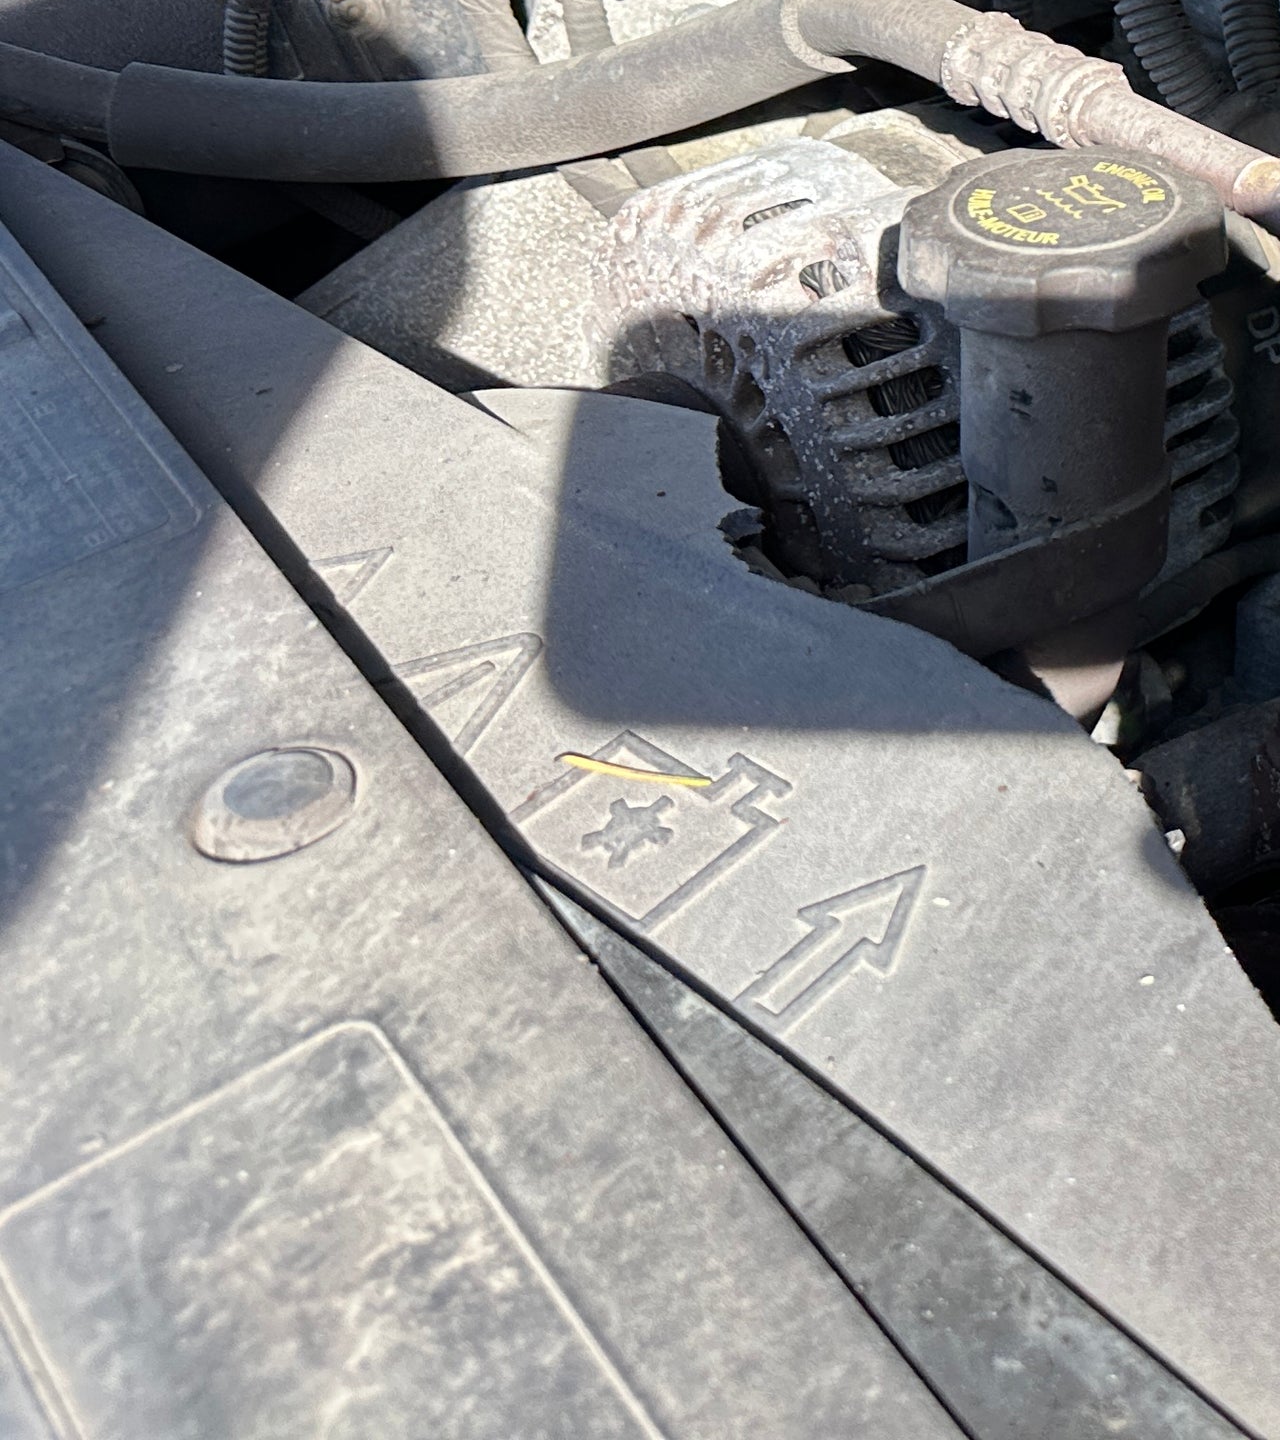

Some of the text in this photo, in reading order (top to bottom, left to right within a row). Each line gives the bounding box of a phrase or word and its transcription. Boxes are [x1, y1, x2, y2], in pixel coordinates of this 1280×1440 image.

[1093, 161, 1167, 205] ENGINE OIL
[967, 188, 1061, 246] HUILE-MOTEUR
